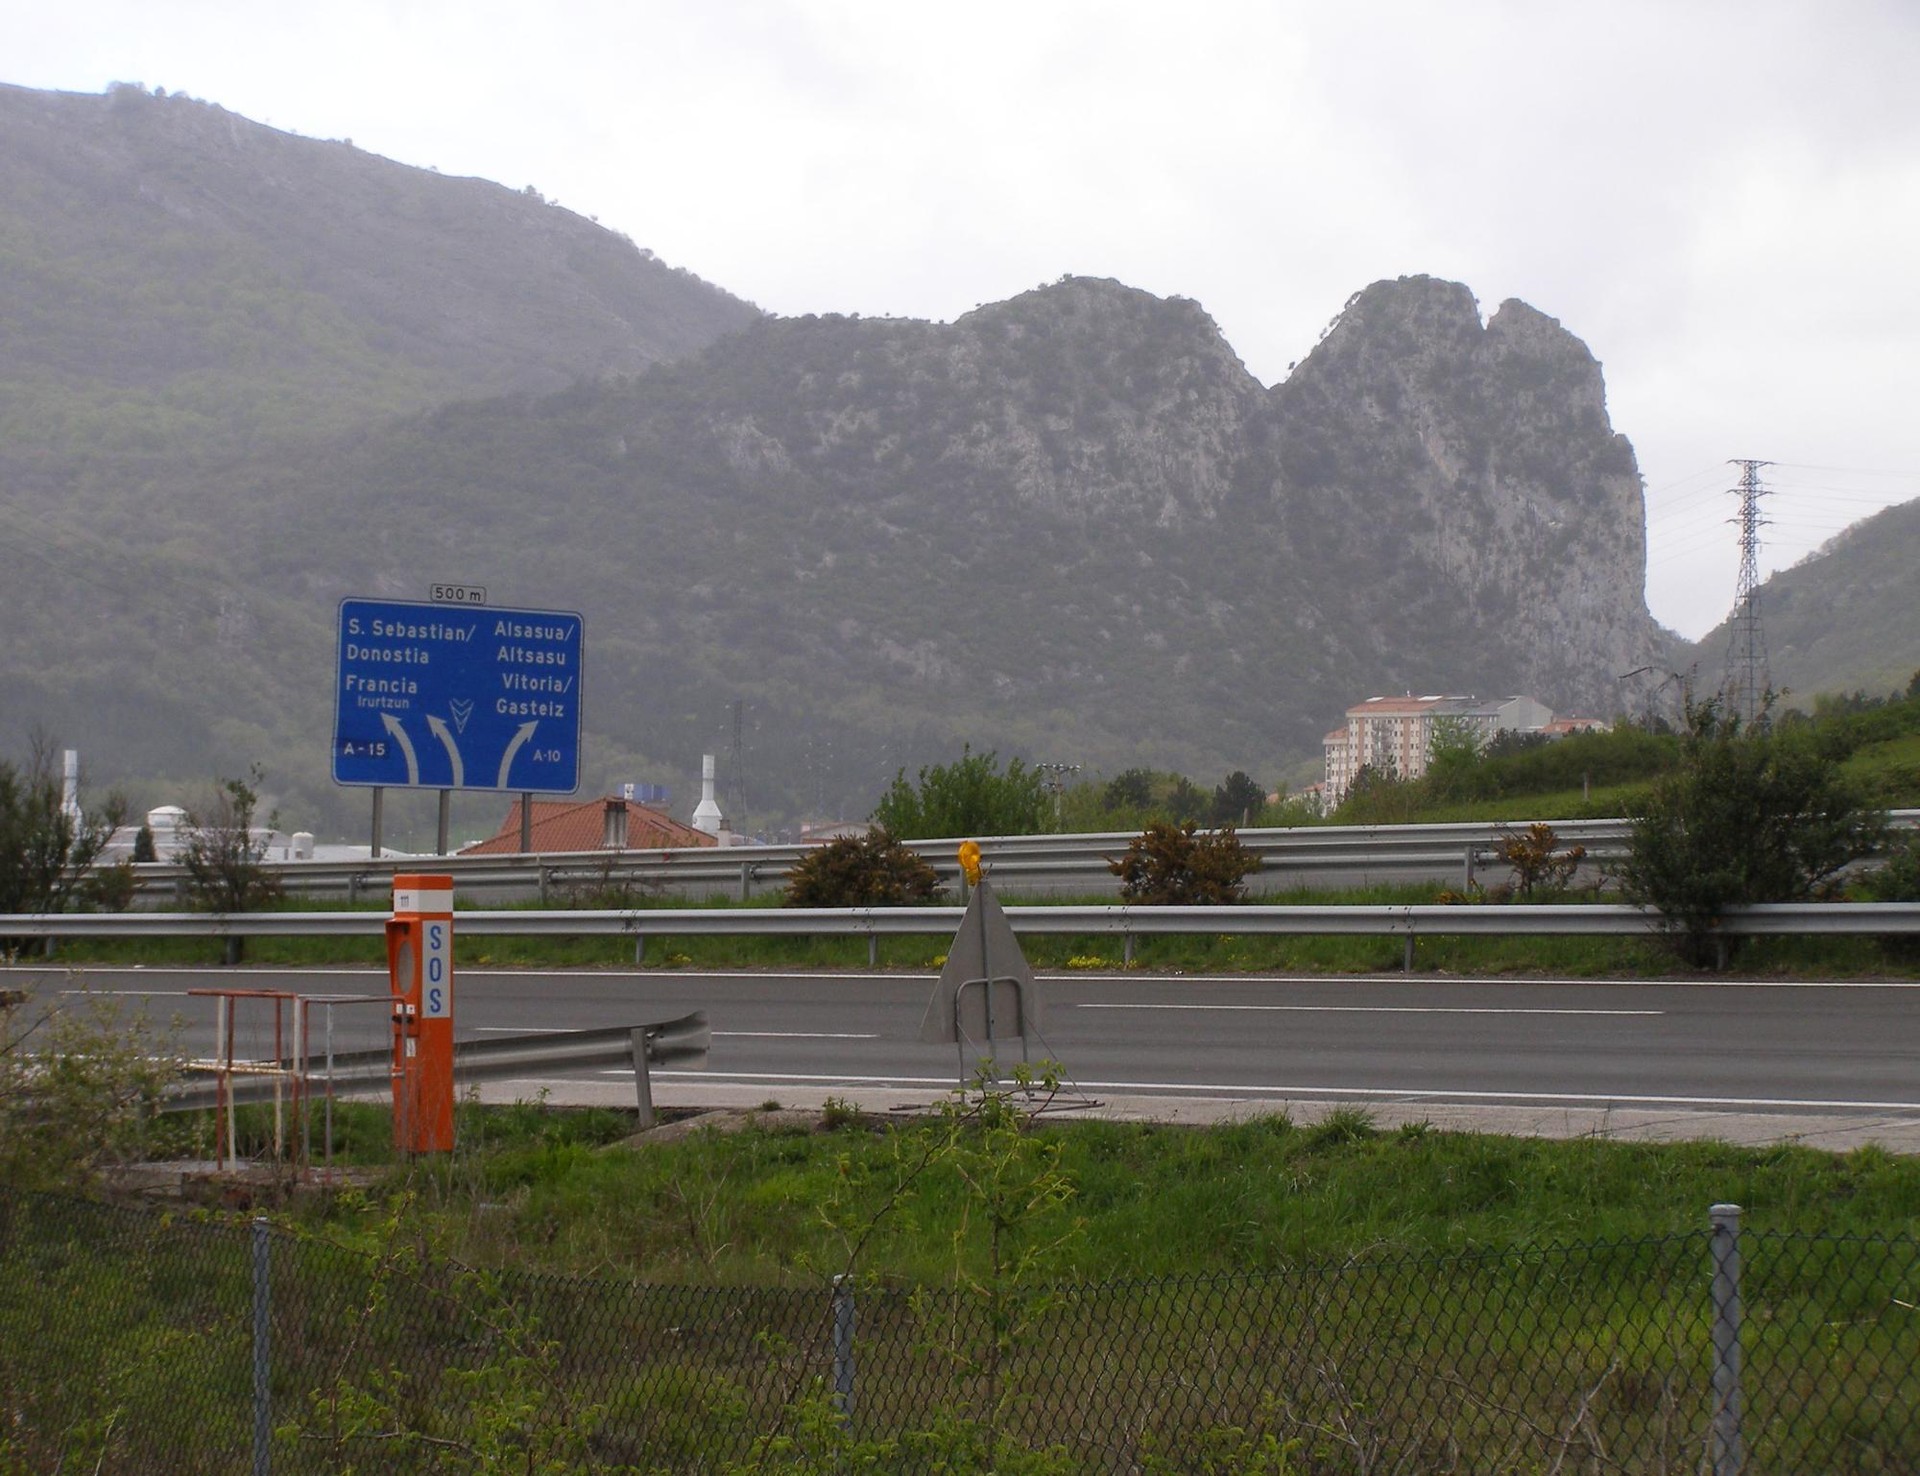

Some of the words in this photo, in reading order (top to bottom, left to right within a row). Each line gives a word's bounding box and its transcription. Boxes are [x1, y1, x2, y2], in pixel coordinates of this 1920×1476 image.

[435, 587, 464, 600] 500
[469, 591, 481, 601] m
[348, 618, 365, 635] S.
[372, 620, 476, 642] Sebastian/
[494, 620, 574, 642] Alsasua/
[346, 644, 430, 664] Donostia
[497, 645, 566, 665] Altsasu
[346, 674, 417, 694] Francia
[502, 673, 573, 694] Vitoria/
[357, 695, 410, 709] Irurtzun
[496, 698, 564, 717] Gasteiz
[533, 749, 561, 762] A-10
[429, 924, 442, 1014] SOS
